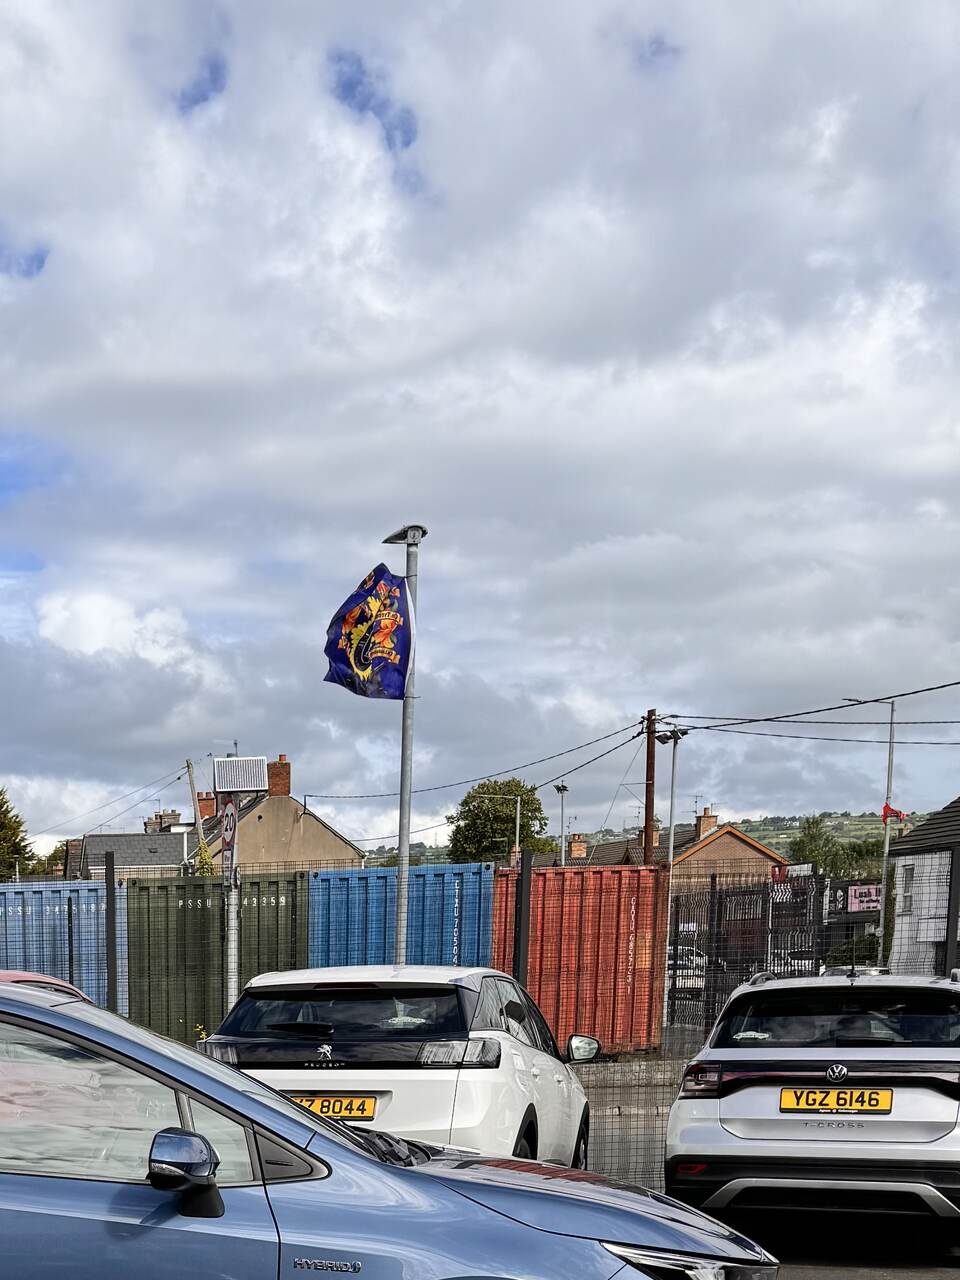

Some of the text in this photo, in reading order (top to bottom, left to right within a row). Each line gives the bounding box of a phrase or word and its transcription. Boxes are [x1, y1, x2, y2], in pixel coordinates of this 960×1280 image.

[224, 812, 234, 833] 20
[178, 899, 212, 909] PSSU
[793, 1090, 880, 1107] YGZ 6146
[320, 1099, 367, 1116] 8044
[294, 1258, 352, 1272] HYBRID
